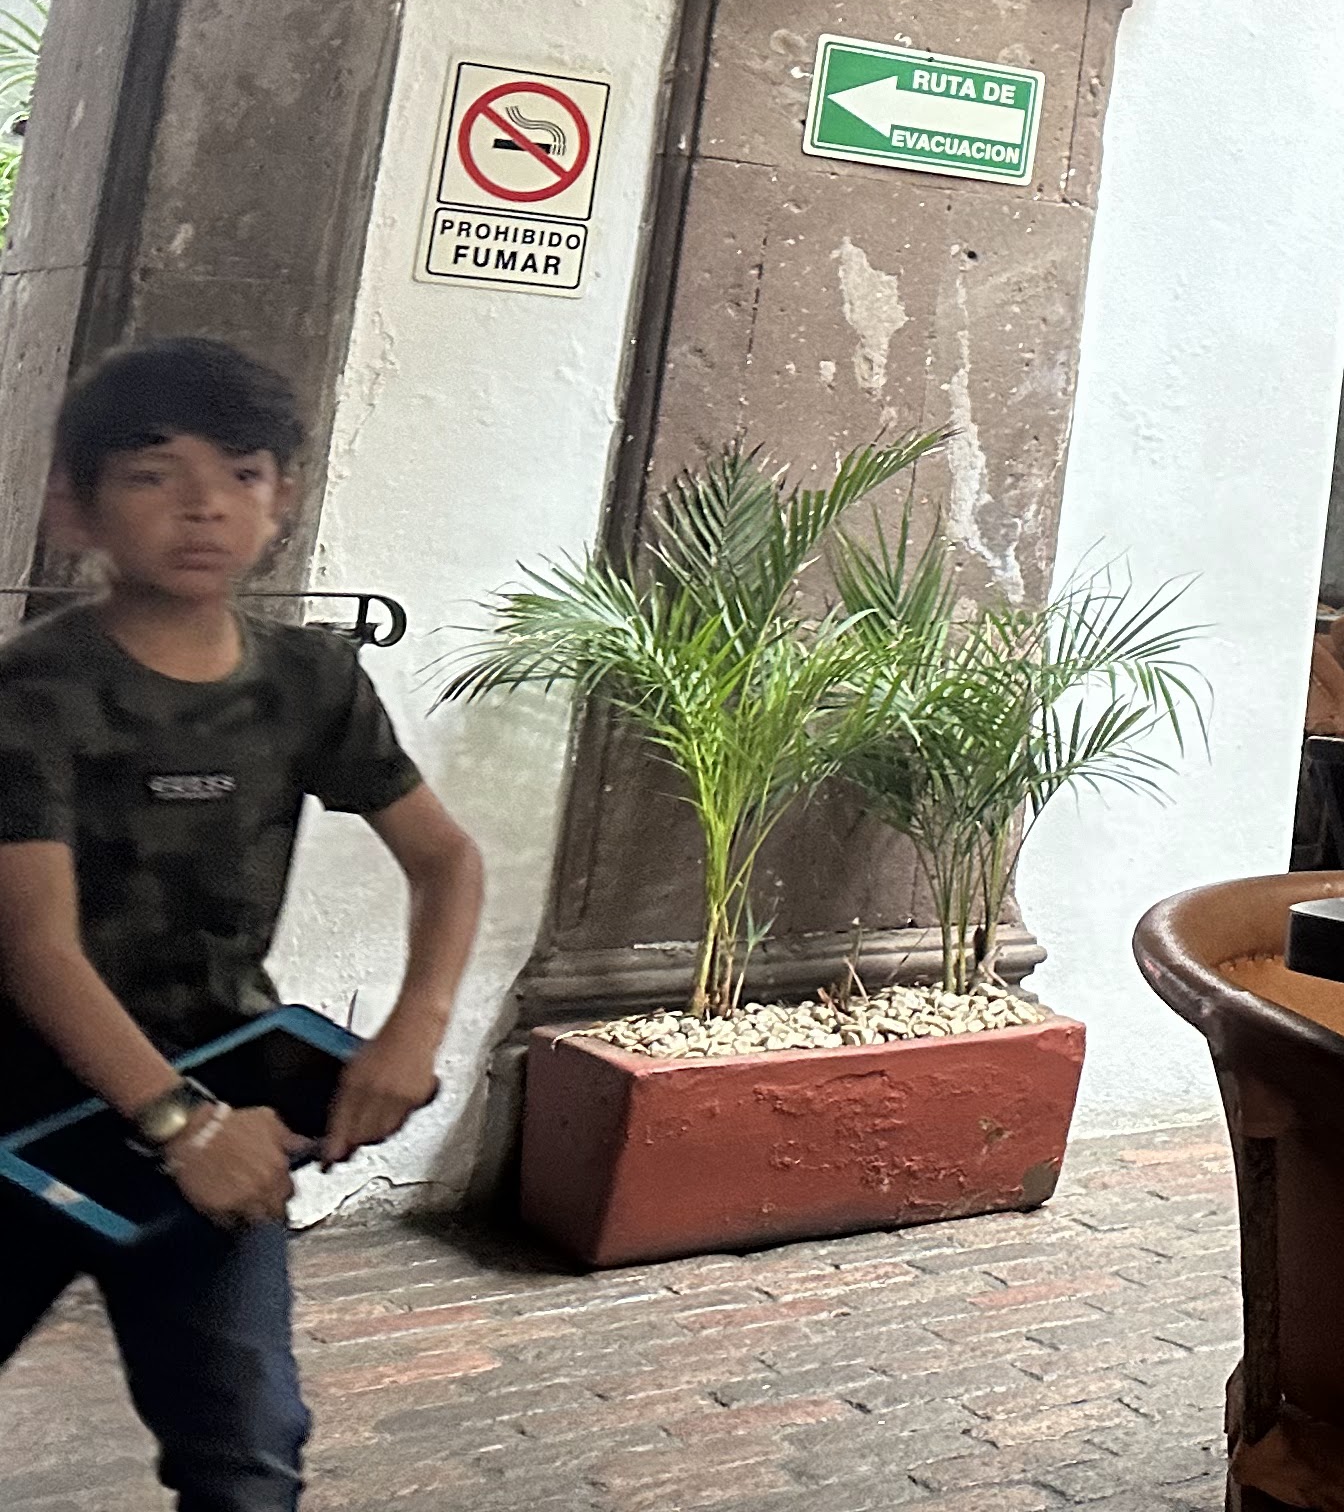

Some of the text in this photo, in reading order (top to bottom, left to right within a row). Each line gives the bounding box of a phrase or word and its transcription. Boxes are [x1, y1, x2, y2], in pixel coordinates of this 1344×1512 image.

[912, 69, 1016, 105] RUTA DE
[891, 129, 1020, 165] EVACUACION
[440, 219, 581, 250] PROHIBIDO
[452, 245, 562, 275] FUMAR
